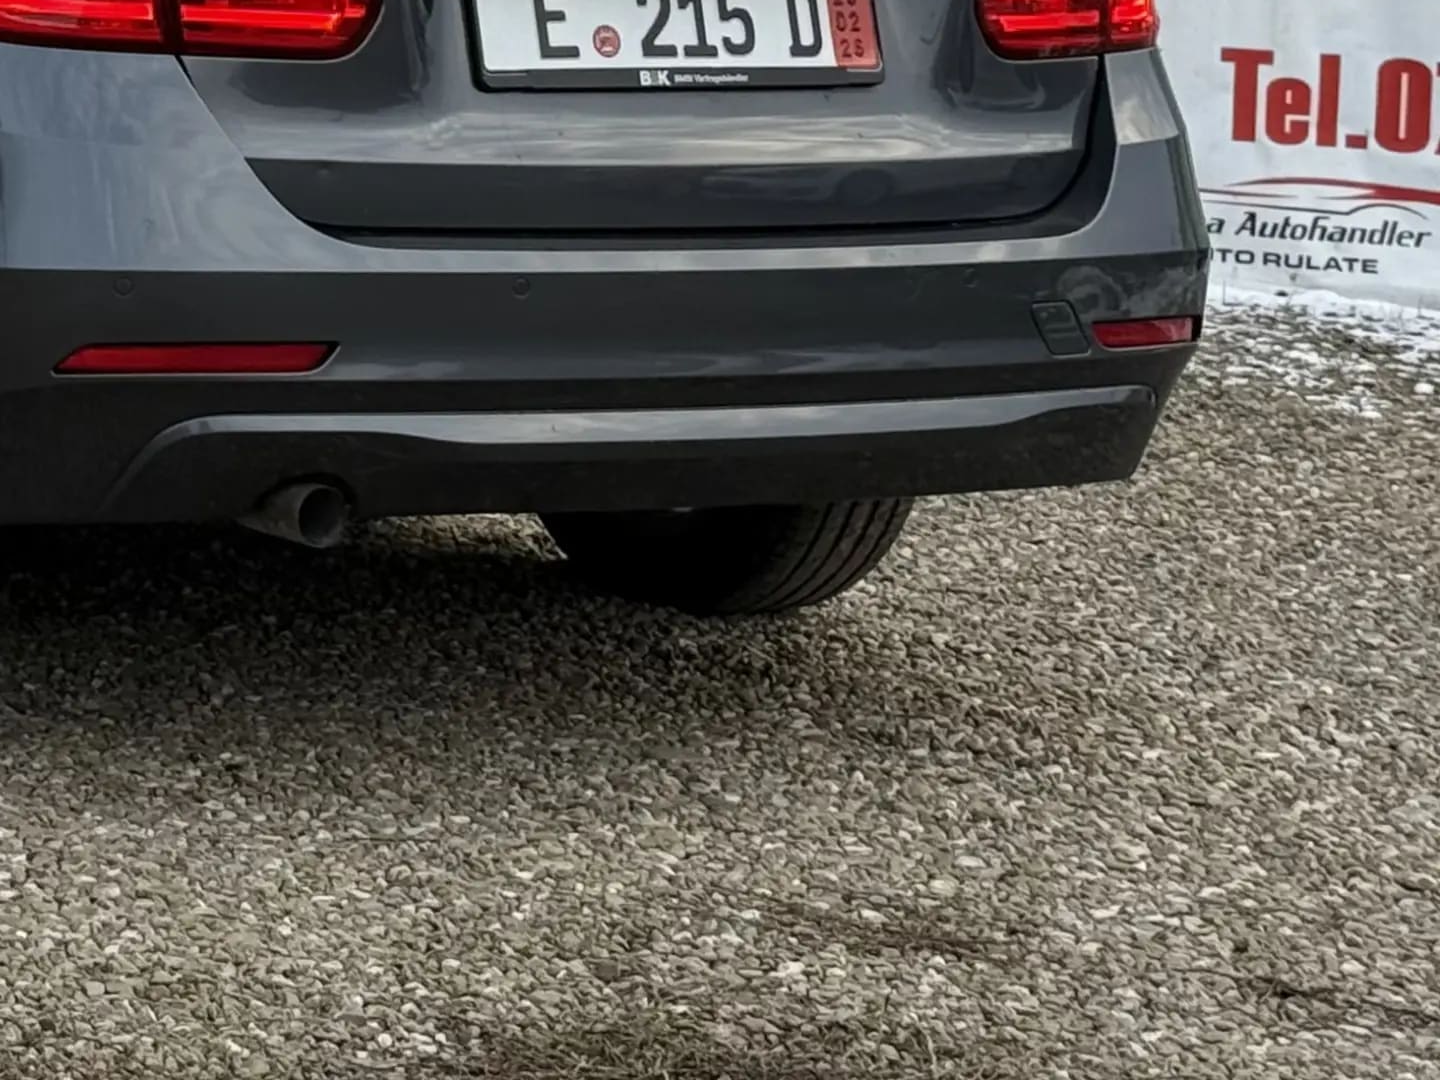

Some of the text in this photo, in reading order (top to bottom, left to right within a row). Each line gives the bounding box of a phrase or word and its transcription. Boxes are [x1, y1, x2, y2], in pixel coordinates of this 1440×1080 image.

[835, 11, 861, 32] 02
[1220, 47, 1440, 154] Tel.0
[1235, 211, 1432, 249] Autohandler
[1263, 251, 1379, 275] RULATE
